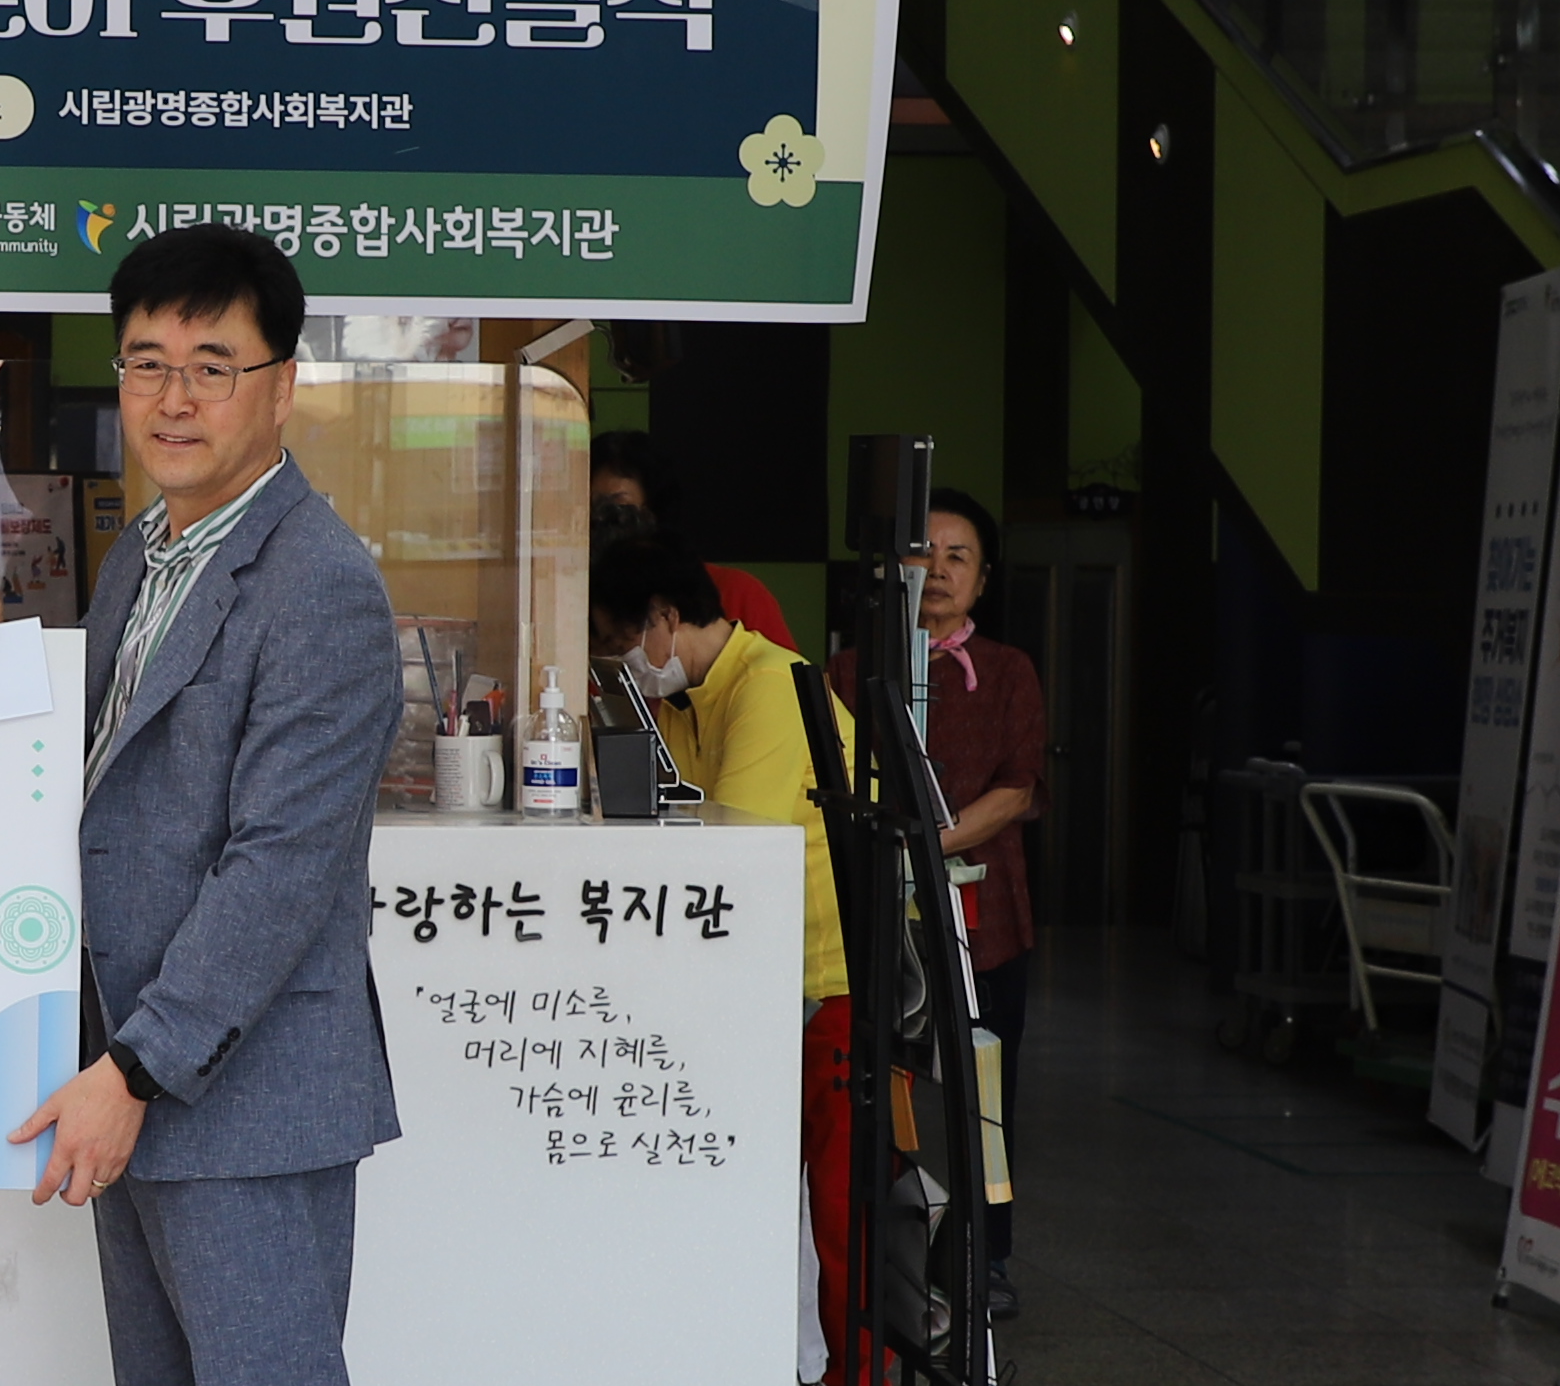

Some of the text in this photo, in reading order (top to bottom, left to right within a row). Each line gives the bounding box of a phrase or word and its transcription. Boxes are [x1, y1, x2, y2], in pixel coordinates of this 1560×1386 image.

[58, 88, 413, 130] 시립광명종합사회복지관
[580, 879, 734, 945] 복지관
[464, 1037, 563, 1072] 머리에
[510, 1082, 599, 1118] 가슴에
[546, 1129, 618, 1165] 몸으로
